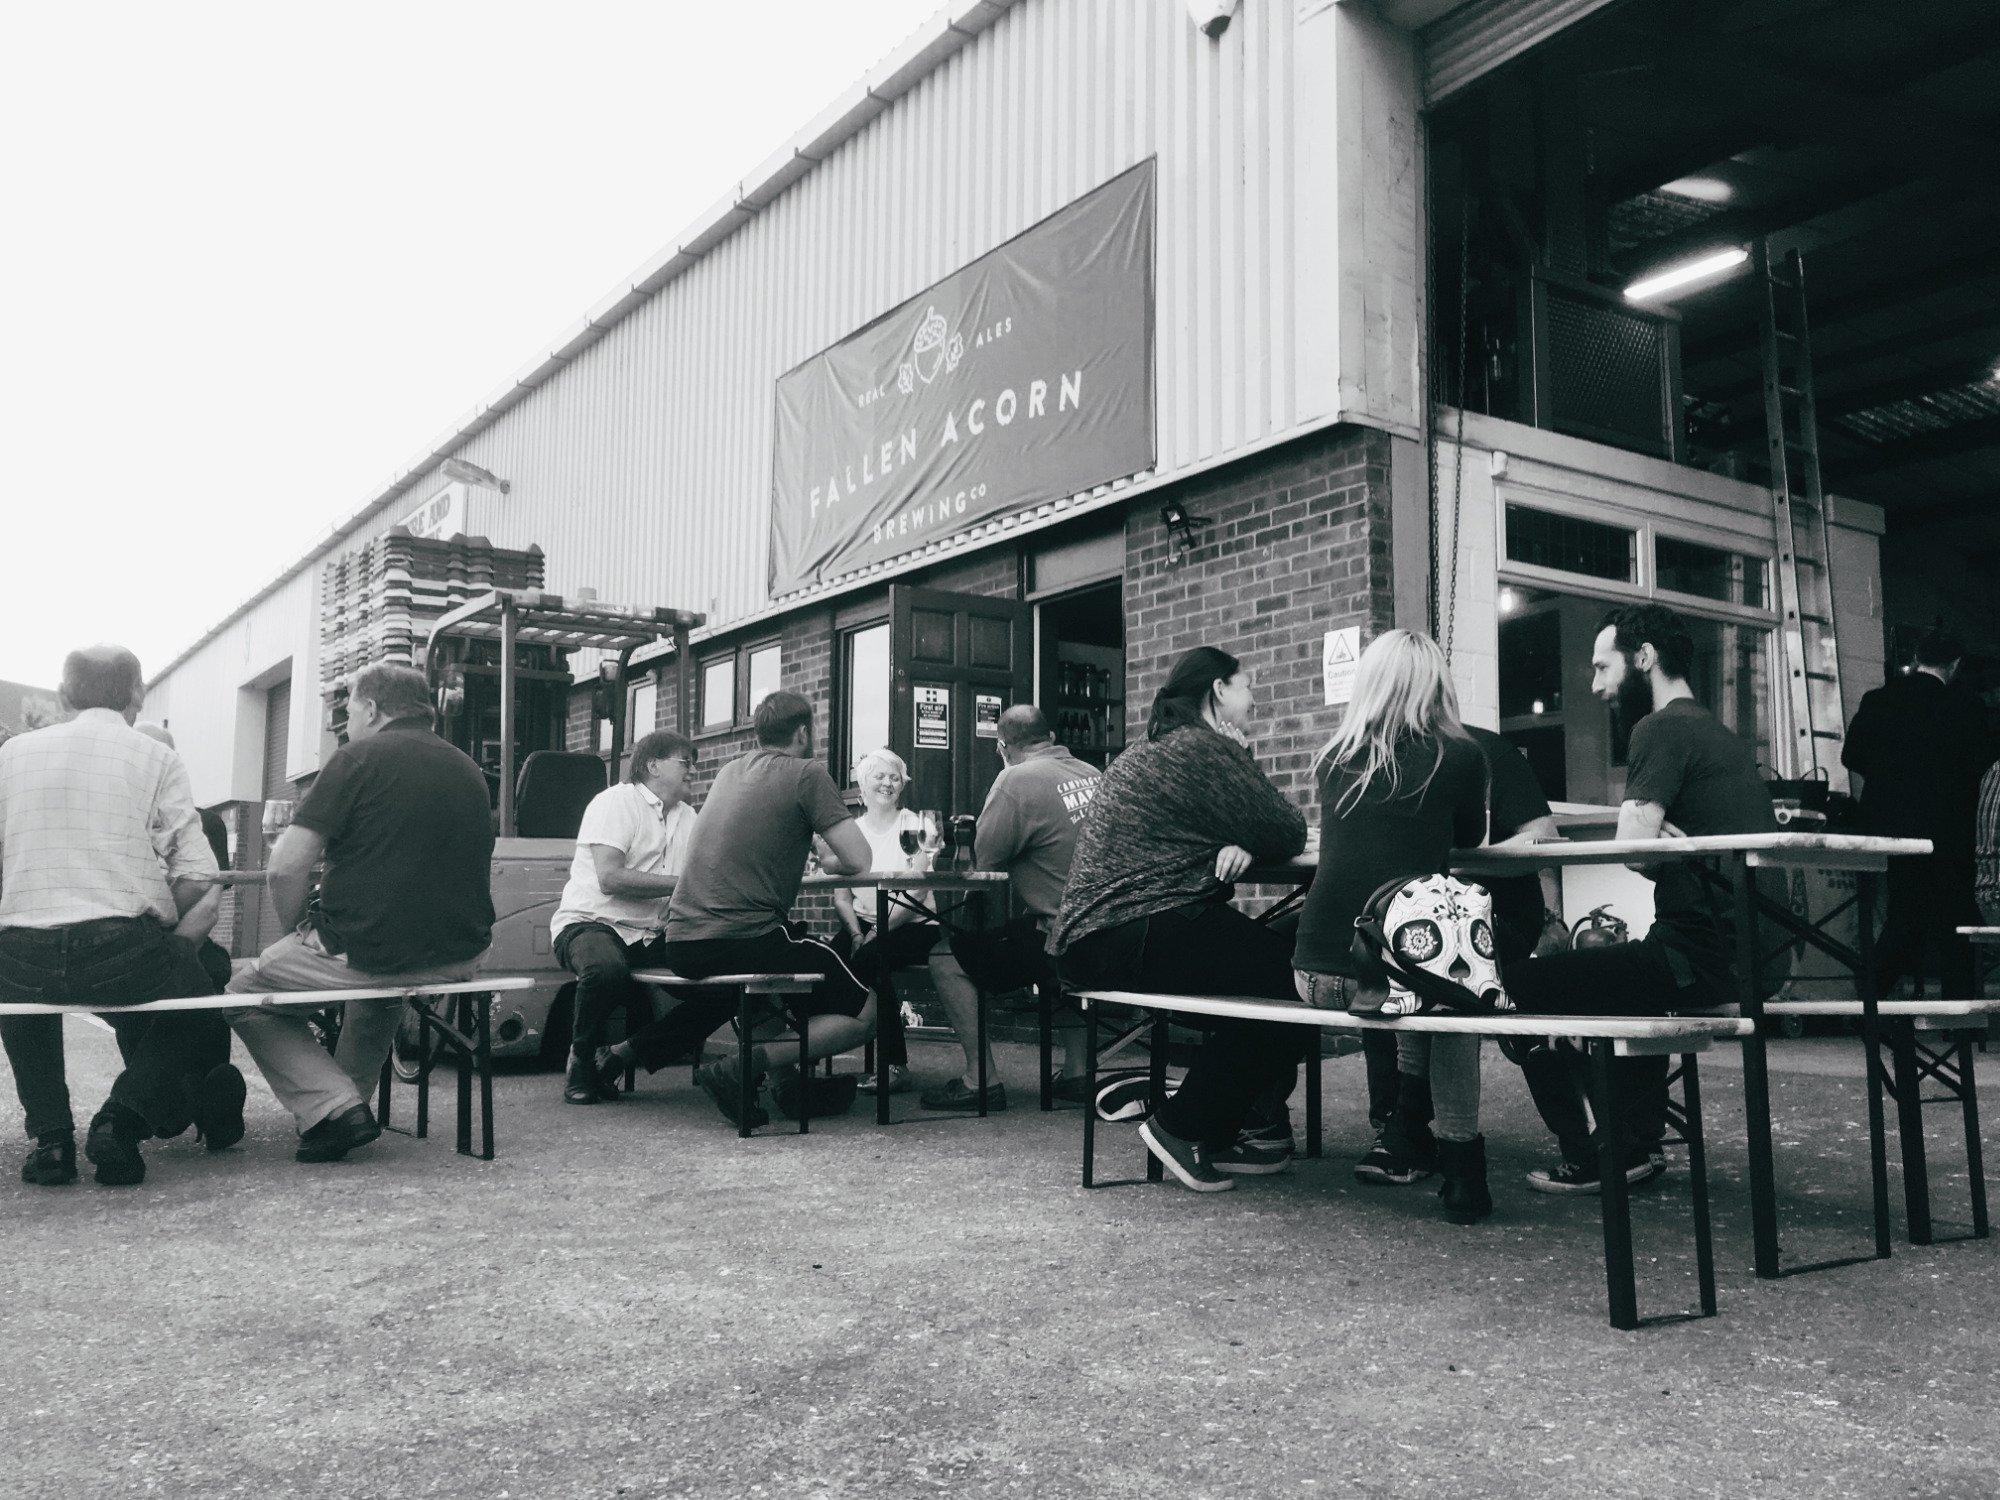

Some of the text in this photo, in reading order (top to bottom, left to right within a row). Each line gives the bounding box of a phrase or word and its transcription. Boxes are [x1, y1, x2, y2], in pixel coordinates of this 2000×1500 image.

[858, 317, 1012, 408] REAL ALES
[810, 371, 1082, 518] FALLEN ACORN
[873, 483, 986, 544] BREWING CO
[1057, 777, 1094, 794] CAMPING
